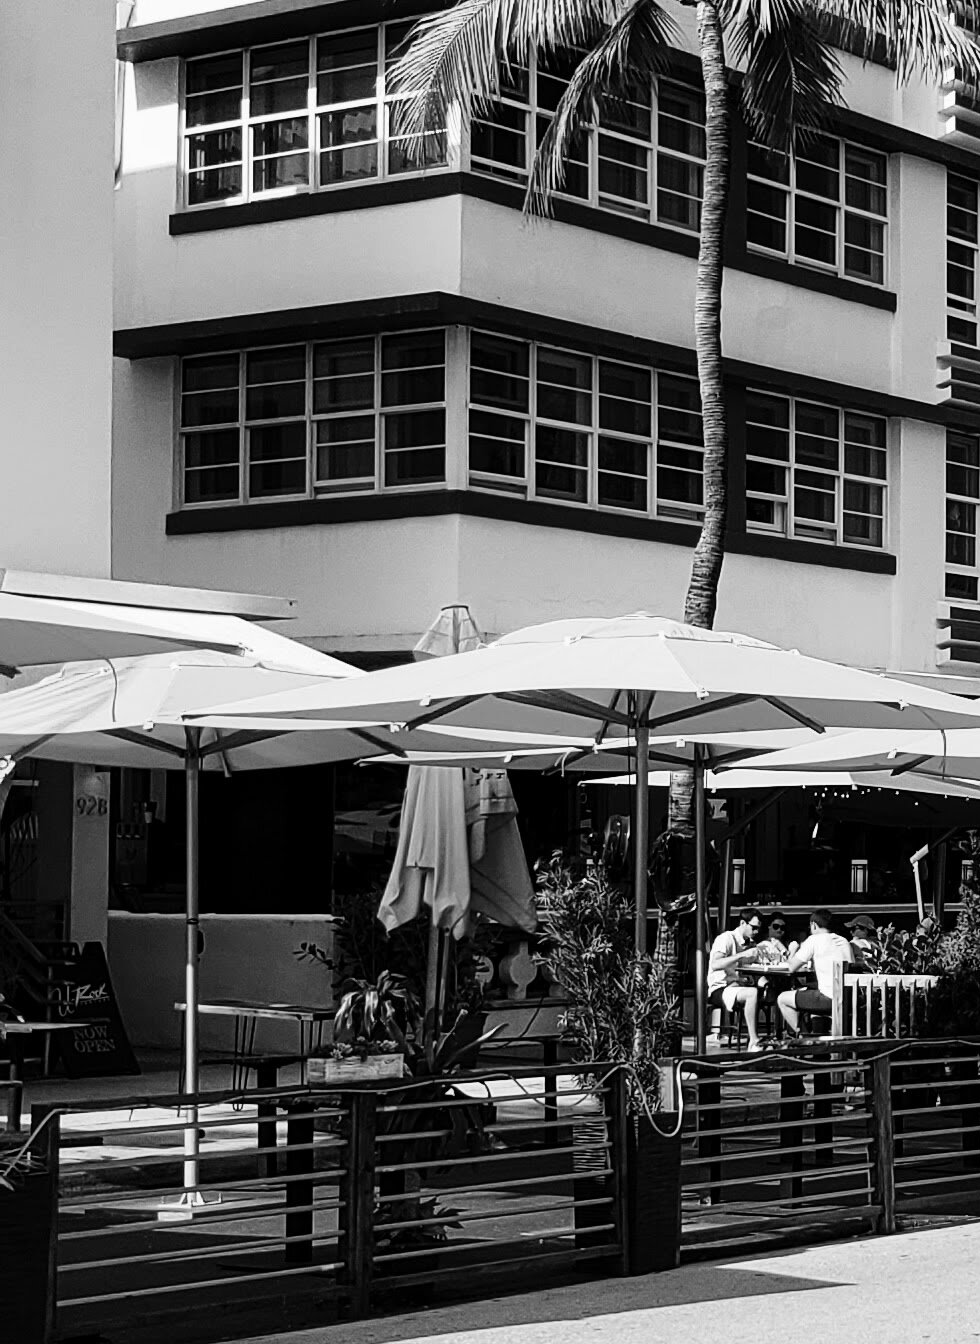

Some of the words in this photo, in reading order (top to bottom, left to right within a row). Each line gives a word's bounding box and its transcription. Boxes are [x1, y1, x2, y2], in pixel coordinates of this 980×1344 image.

[76, 796, 108, 816] 928
[73, 1025, 107, 1040] NOW
[74, 1039, 116, 1053] OPEN
